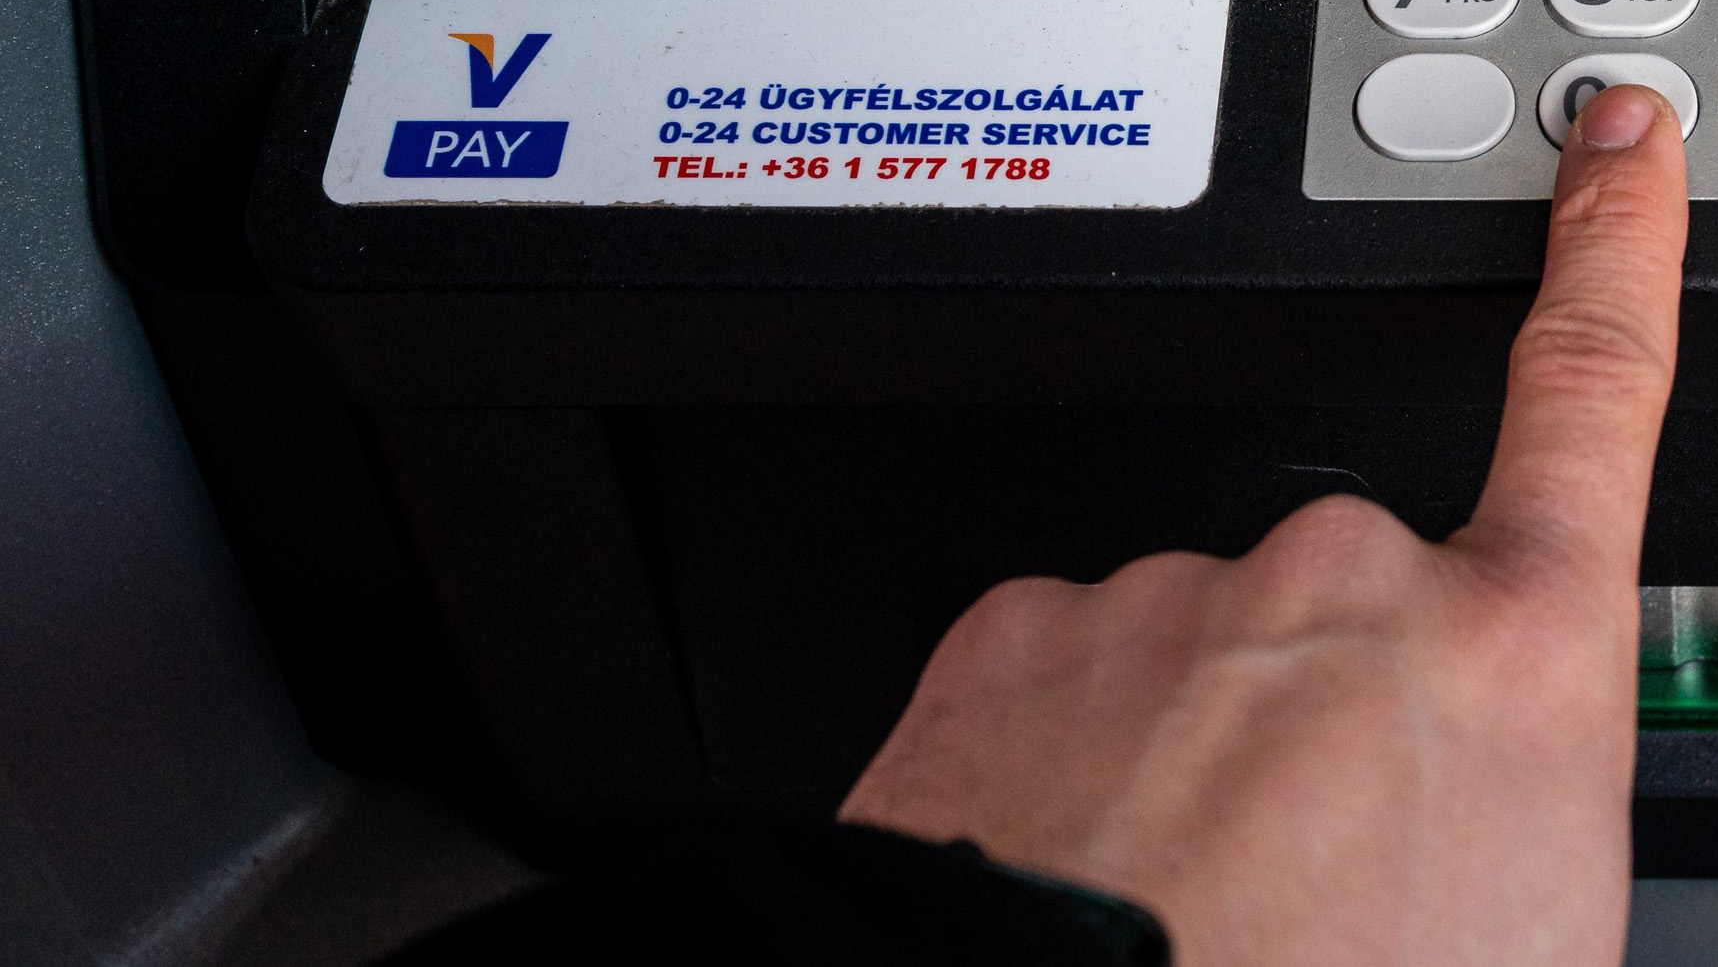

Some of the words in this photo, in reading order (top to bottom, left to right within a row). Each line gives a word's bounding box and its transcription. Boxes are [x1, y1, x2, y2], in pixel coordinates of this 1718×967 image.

[448, 33, 552, 108] V
[667, 87, 746, 109] 0-24
[760, 84, 1143, 111] ÜGYFÉLSZOLGÁLAT
[659, 122, 739, 143] 0-24
[752, 122, 969, 145] CUSTOMER
[982, 123, 1150, 145] SERVICE
[425, 131, 531, 167] PAY
[654, 157, 747, 178] TEL.:
[762, 157, 829, 179] +36
[845, 157, 860, 178] 1
[877, 158, 947, 179] 577
[961, 158, 1050, 180] 1788
